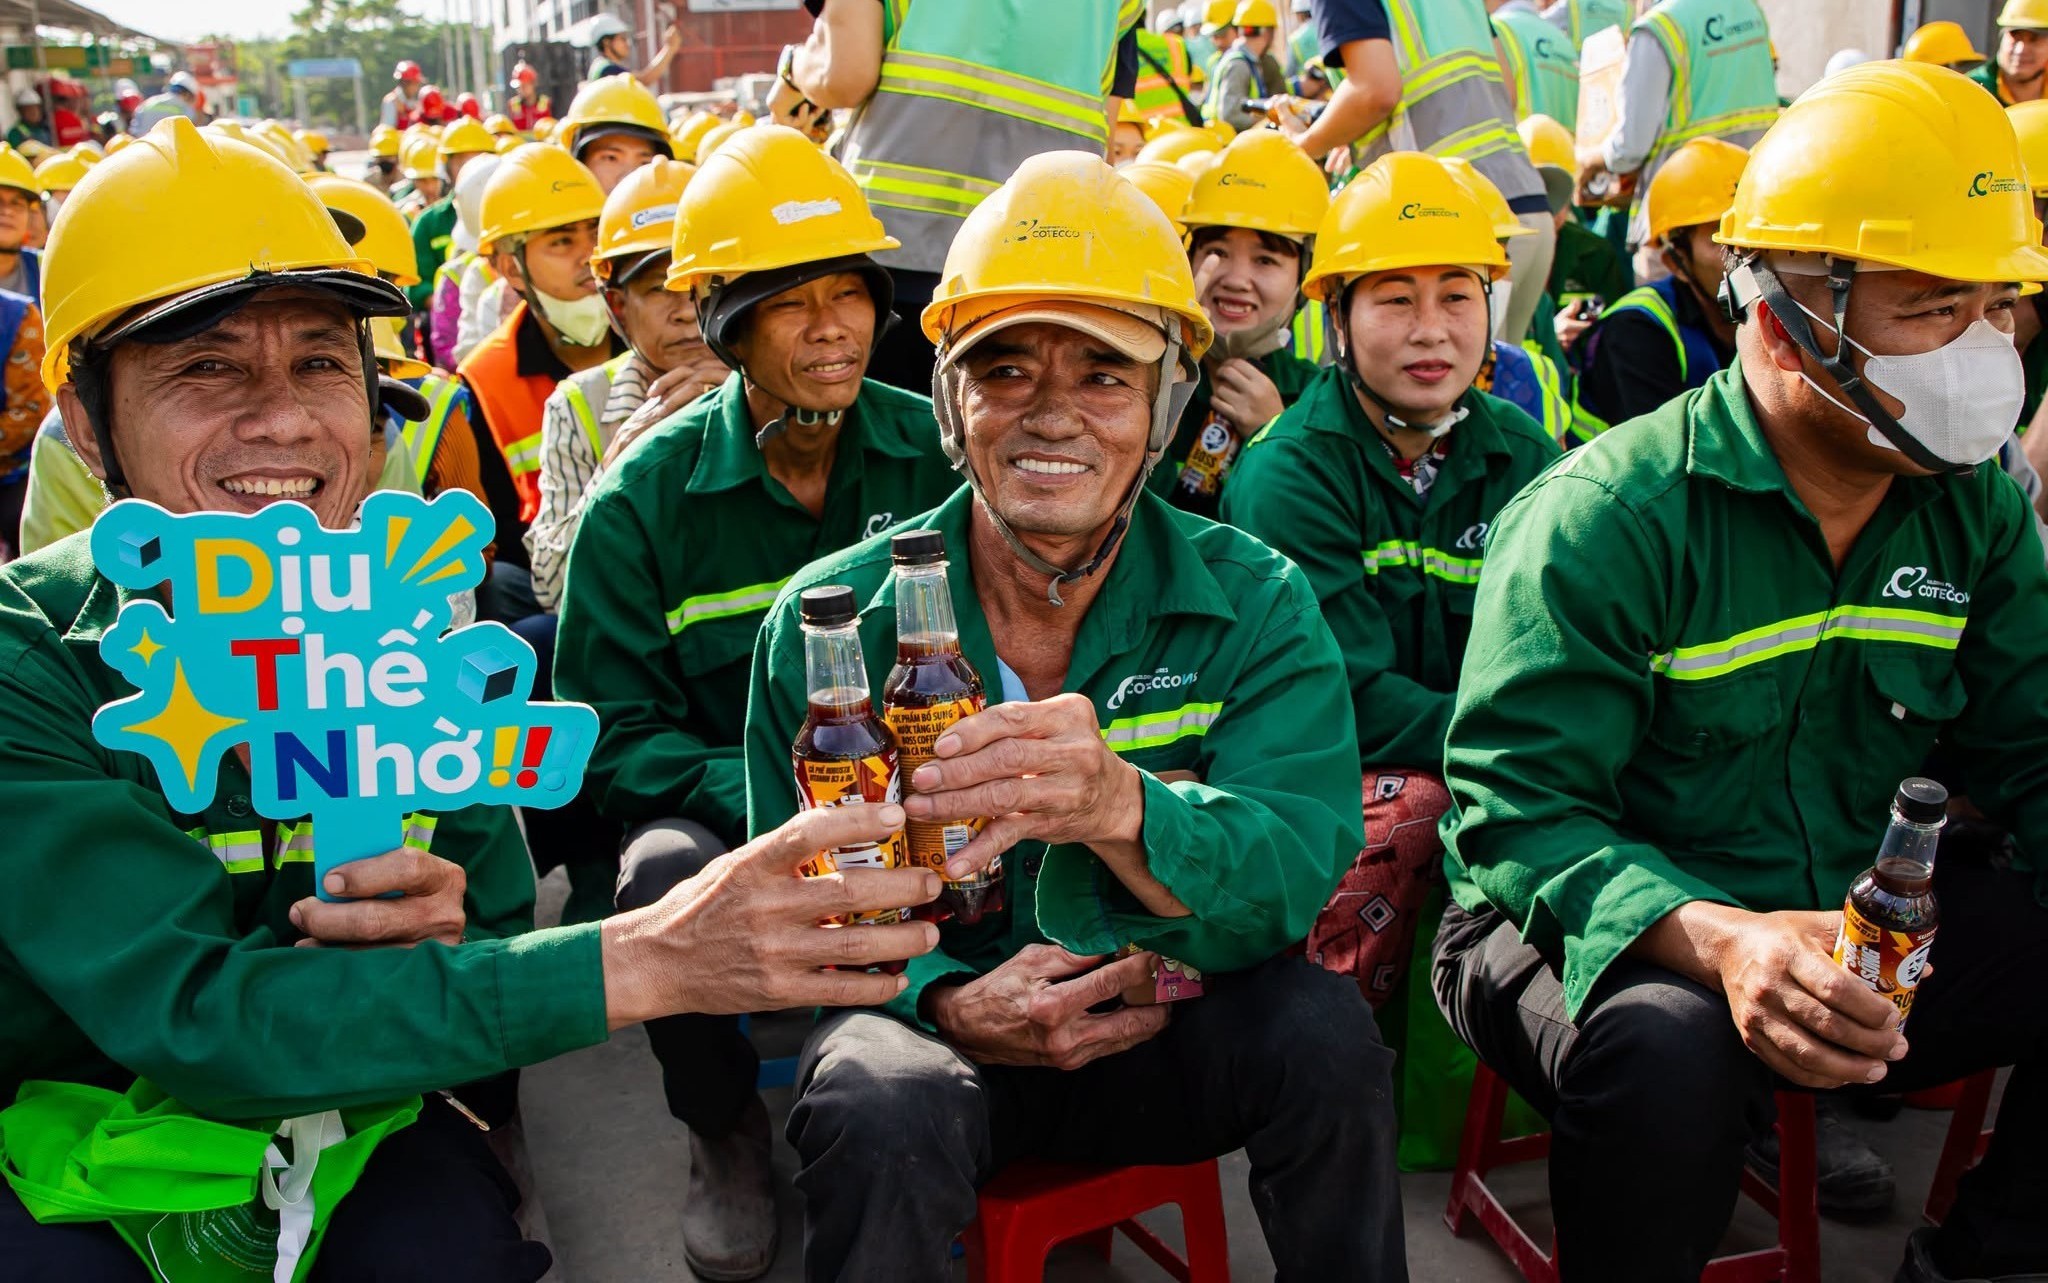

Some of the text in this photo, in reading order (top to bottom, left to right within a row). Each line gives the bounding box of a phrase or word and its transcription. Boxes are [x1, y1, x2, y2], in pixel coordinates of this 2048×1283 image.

[194, 526, 372, 635] Dịu
[231, 608, 434, 711] Thế
[933, 709, 953, 721] SUNG
[1168, 986, 1178, 997] 12
